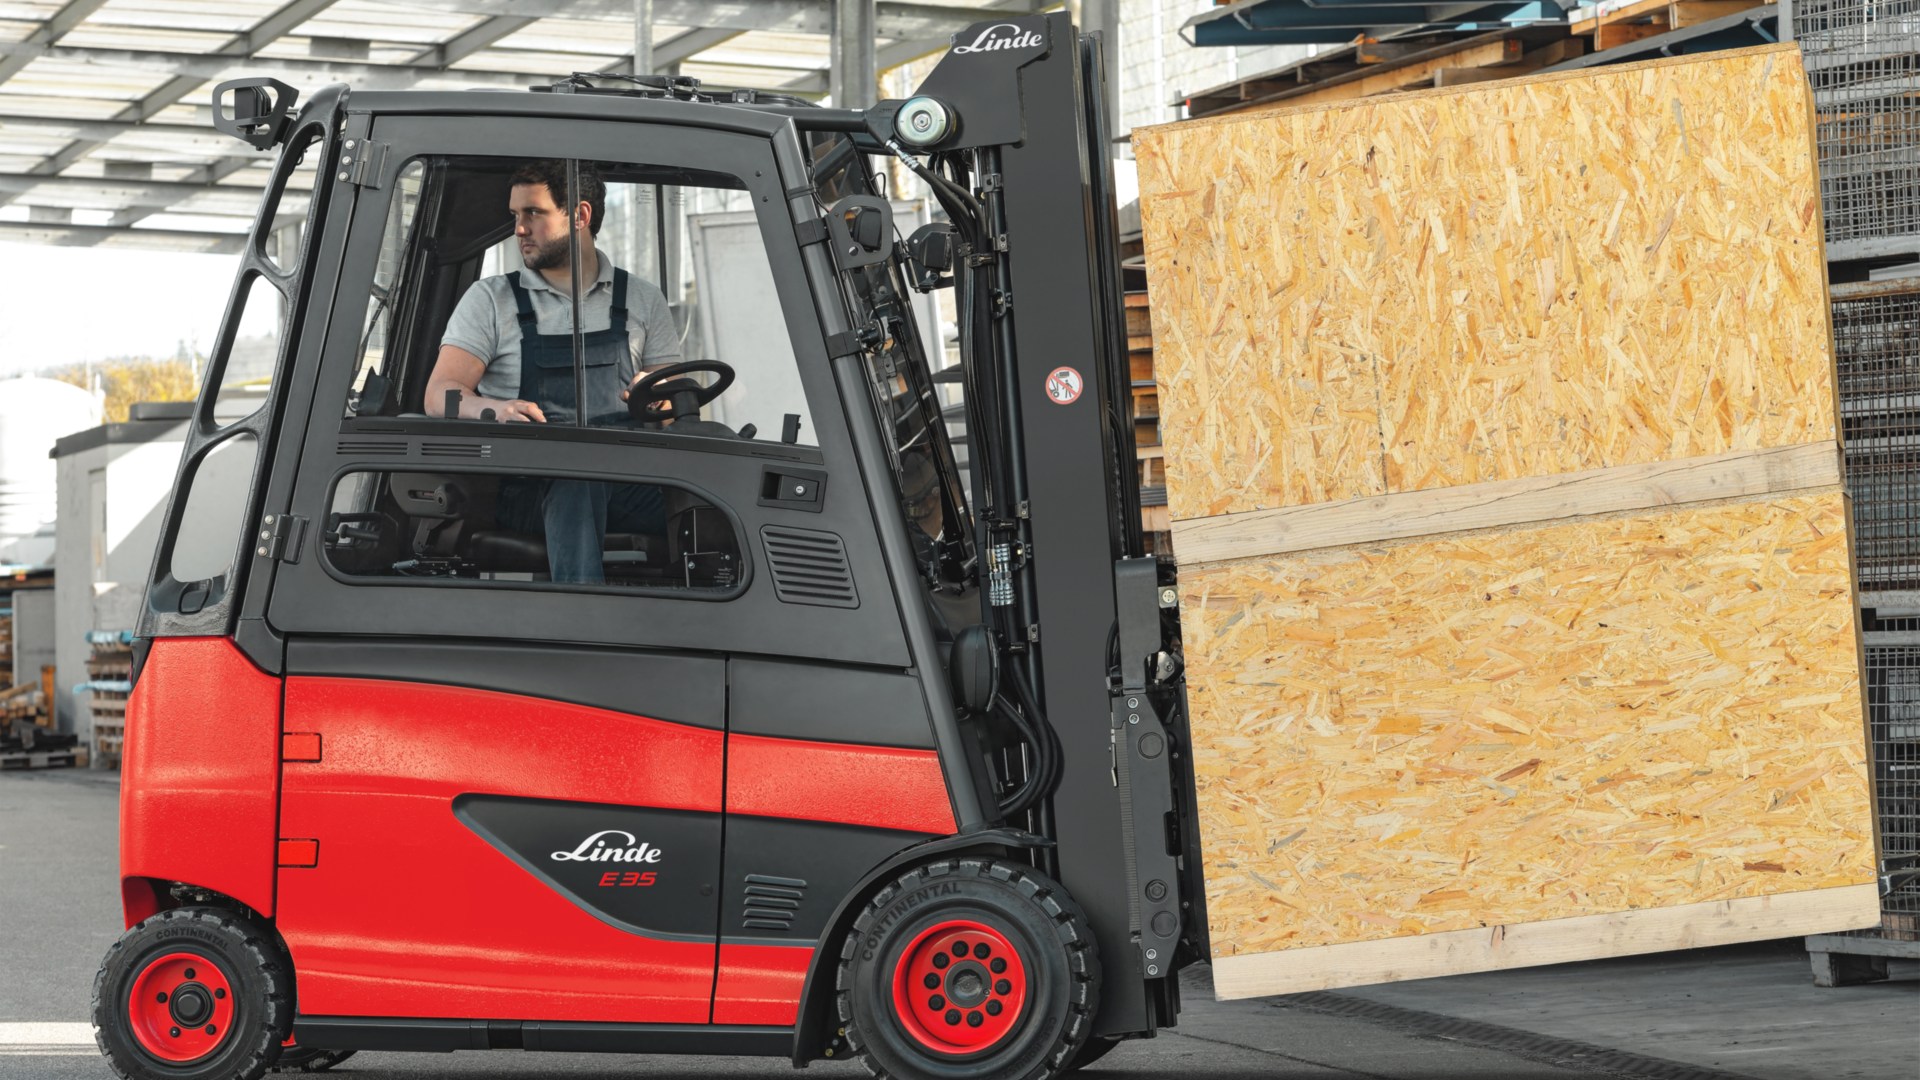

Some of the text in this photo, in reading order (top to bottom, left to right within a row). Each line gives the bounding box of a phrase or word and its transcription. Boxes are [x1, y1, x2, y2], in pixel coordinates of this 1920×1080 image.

[953, 23, 1042, 54] Linde
[550, 829, 661, 863] Linde
[598, 871, 658, 887] E 35
[858, 882, 963, 961] CONTINENTAL
[155, 927, 229, 951] CONTINENTAL
